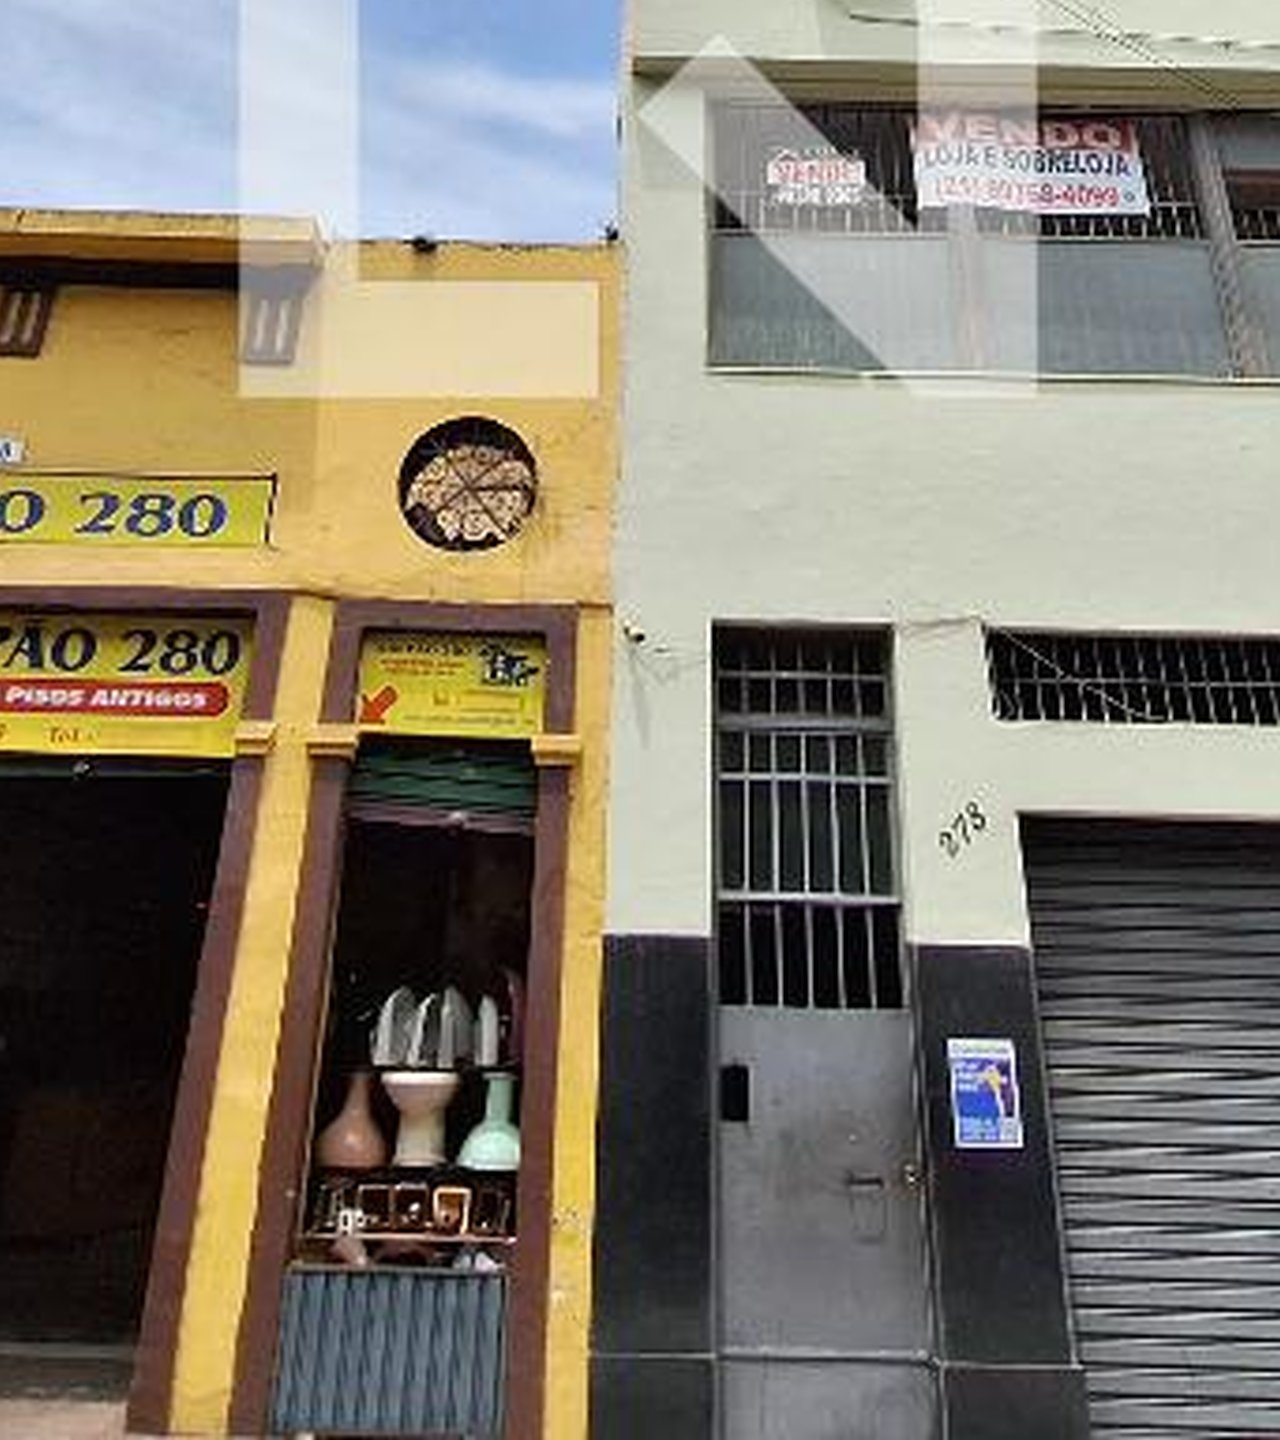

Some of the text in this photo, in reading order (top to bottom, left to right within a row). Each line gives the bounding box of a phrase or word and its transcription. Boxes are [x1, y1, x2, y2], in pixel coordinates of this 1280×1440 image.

[74, 494, 227, 537] 280
[119, 629, 240, 675] 280
[4, 687, 84, 707] PISOS
[89, 689, 208, 709] ANTIGOS
[939, 802, 987, 858] 278
